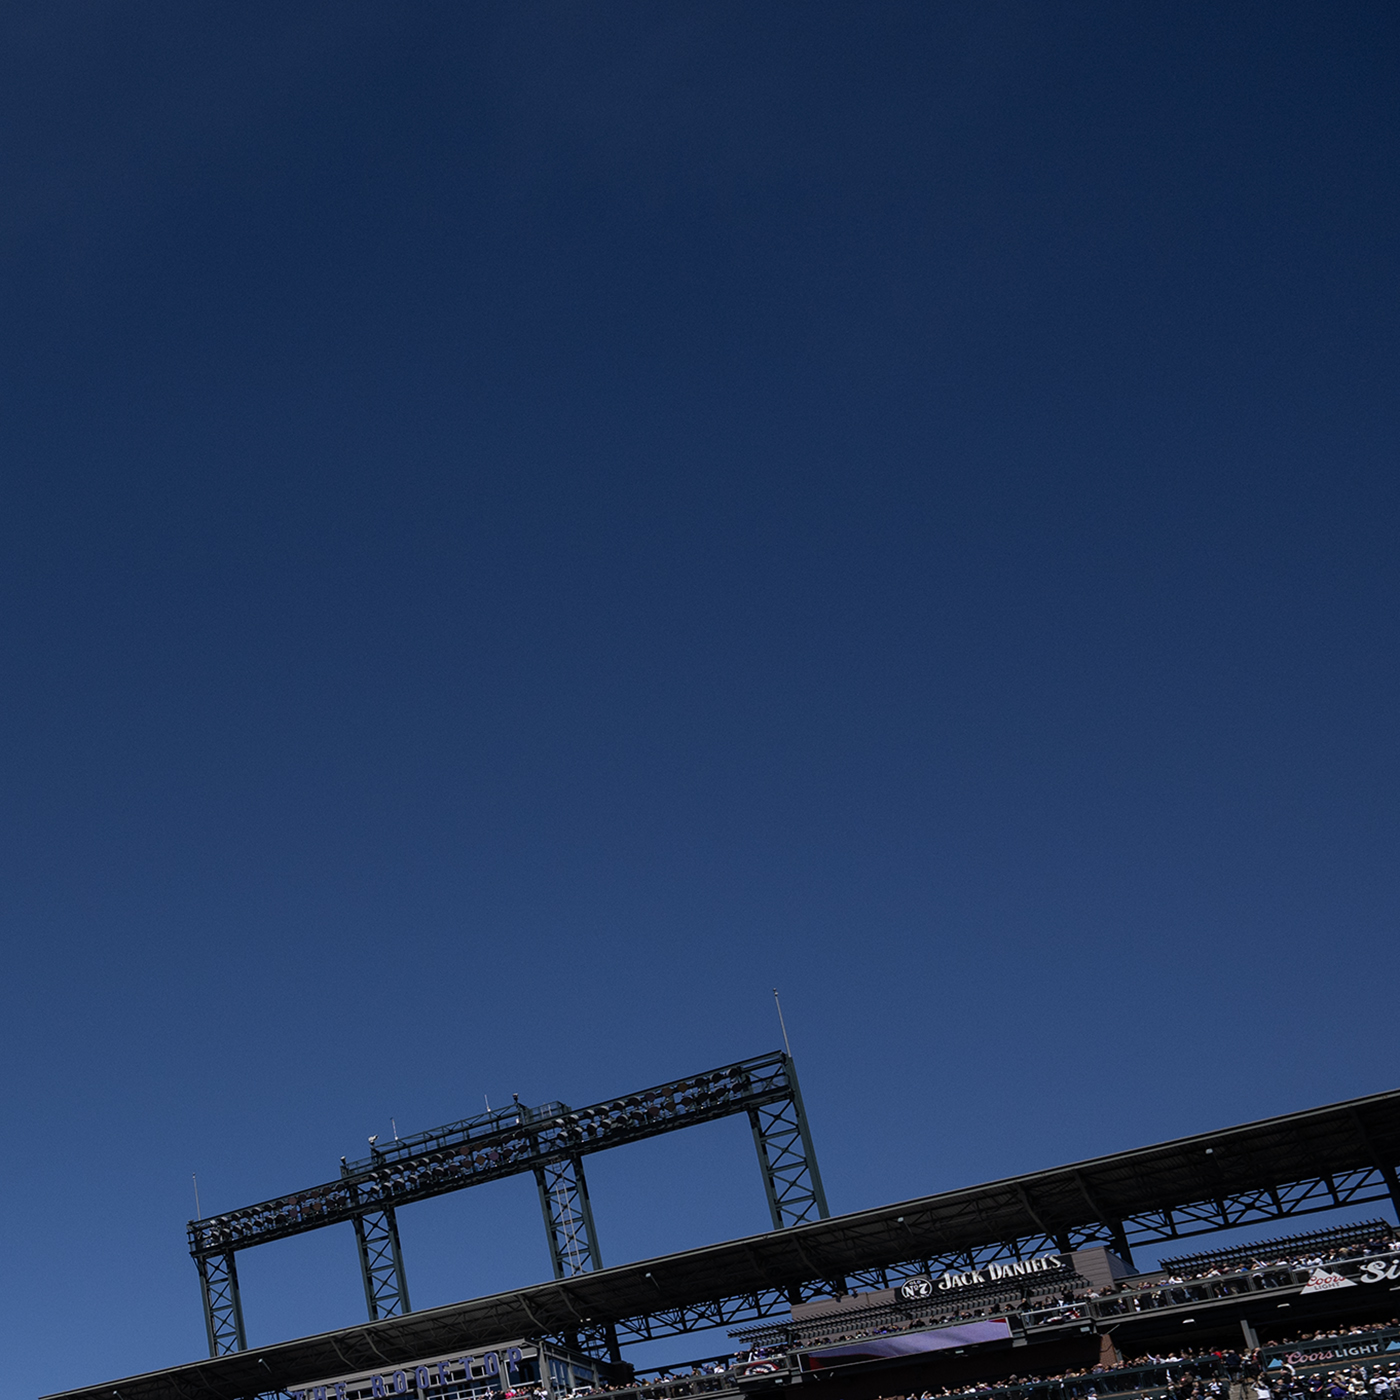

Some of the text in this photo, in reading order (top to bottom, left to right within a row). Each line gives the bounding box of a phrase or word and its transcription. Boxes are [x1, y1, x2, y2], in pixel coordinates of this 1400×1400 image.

[938, 1254, 1063, 1290] JACK DANIEL'S
[1307, 1275, 1346, 1287] Coors
[1314, 1282, 1341, 1290] LIGHT
[1285, 1344, 1380, 1364] Coors LIGHT
[370, 1347, 523, 1399] ROOFTOP
